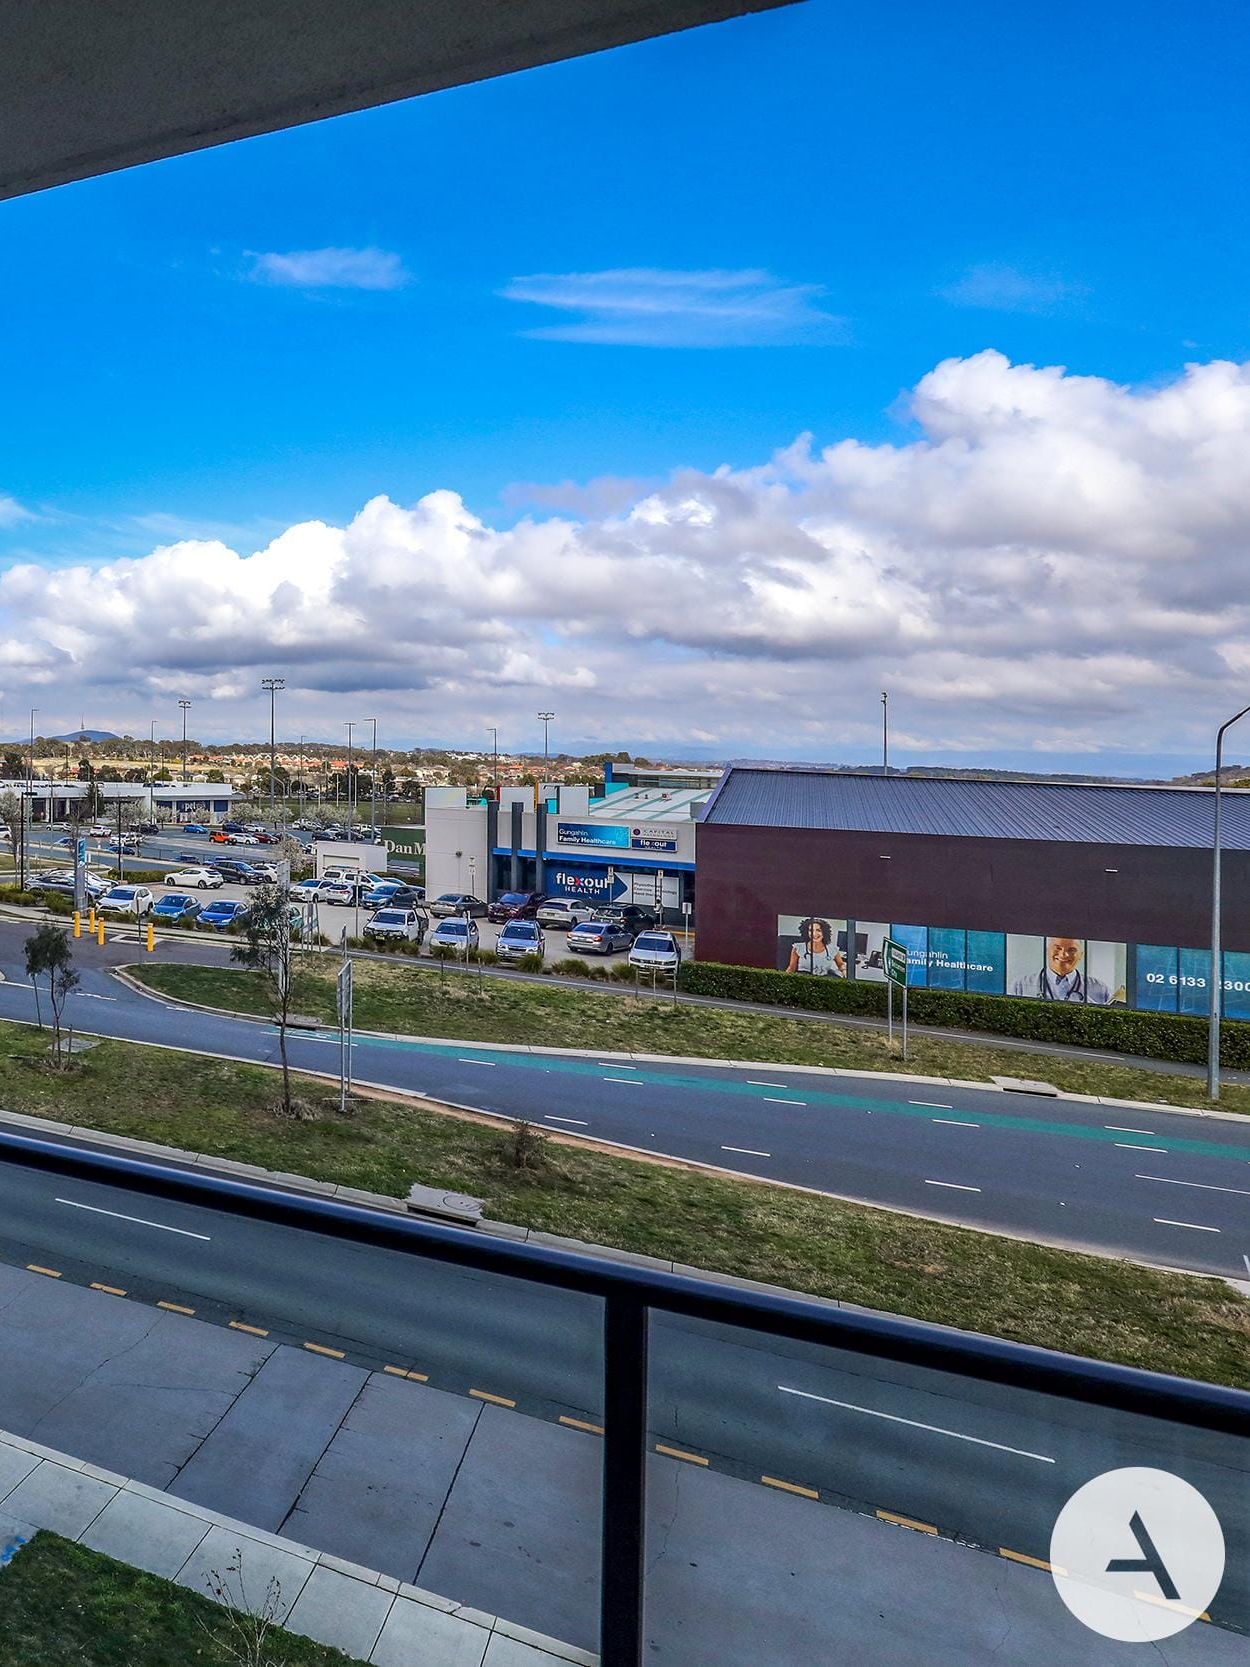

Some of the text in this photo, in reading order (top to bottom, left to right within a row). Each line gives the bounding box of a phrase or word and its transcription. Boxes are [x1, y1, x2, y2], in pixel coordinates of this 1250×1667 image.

[558, 828, 589, 837] Gungahlin
[559, 835, 617, 846] Family Healthcare
[384, 839, 413, 854] Dan
[564, 886, 600, 895] HEALTH
[907, 950, 948, 959] ungahlin
[907, 957, 994, 972] amily Healthcare
[1146, 973, 1164, 984] 02
[1168, 976, 1206, 987] 6133
